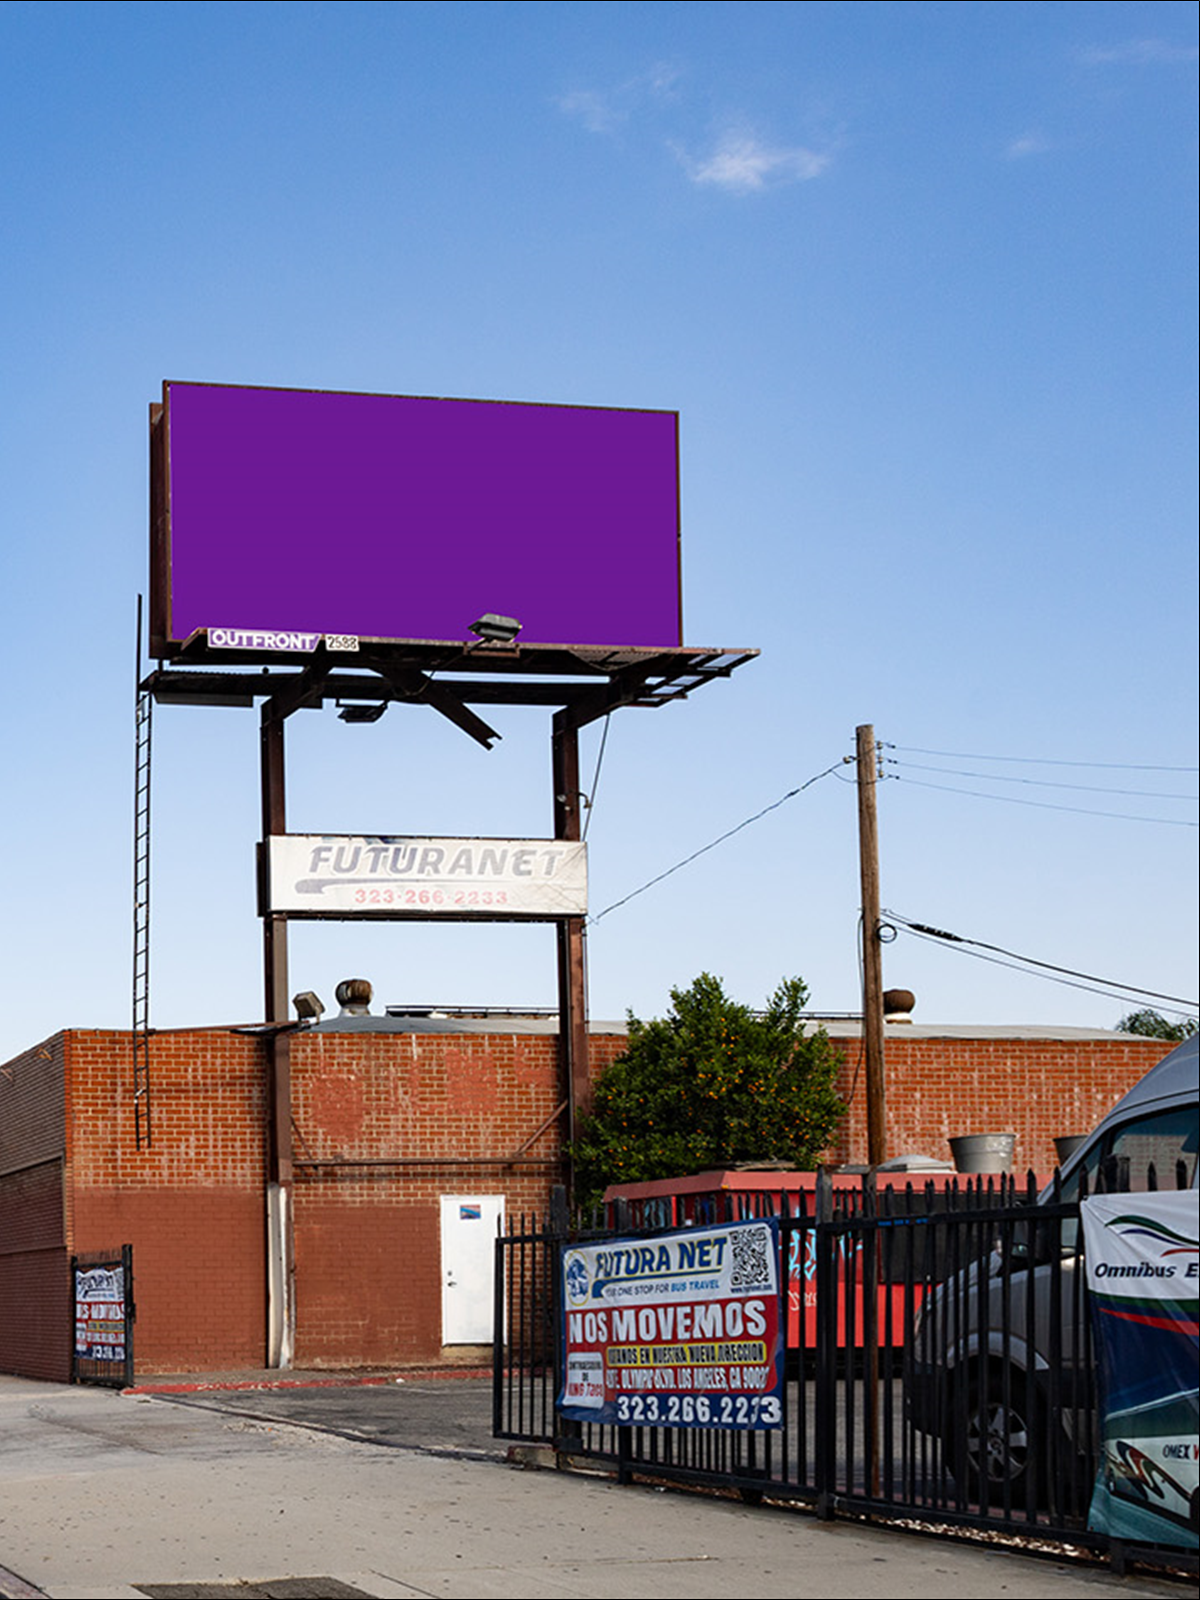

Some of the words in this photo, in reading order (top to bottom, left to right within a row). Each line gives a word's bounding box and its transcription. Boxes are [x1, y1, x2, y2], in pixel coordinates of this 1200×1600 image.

[211, 630, 315, 650] OUTFRONT
[308, 845, 564, 877] FUTURANET
[594, 1245, 671, 1279] FUTURA
[677, 1237, 728, 1270] NET
[1094, 1262, 1177, 1278] Omnibus
[1184, 1262, 1199, 1278] E
[634, 1284, 654, 1296] STOP
[655, 1282, 669, 1294] FOR
[671, 1282, 687, 1293] BUS
[689, 1279, 719, 1291] TRAVEL
[569, 1312, 608, 1344] NOS
[612, 1301, 767, 1342] MOVEMOS
[678, 1368, 692, 1389] LOS
[730, 1366, 742, 1389] CA
[1163, 1444, 1191, 1460] OMEX
